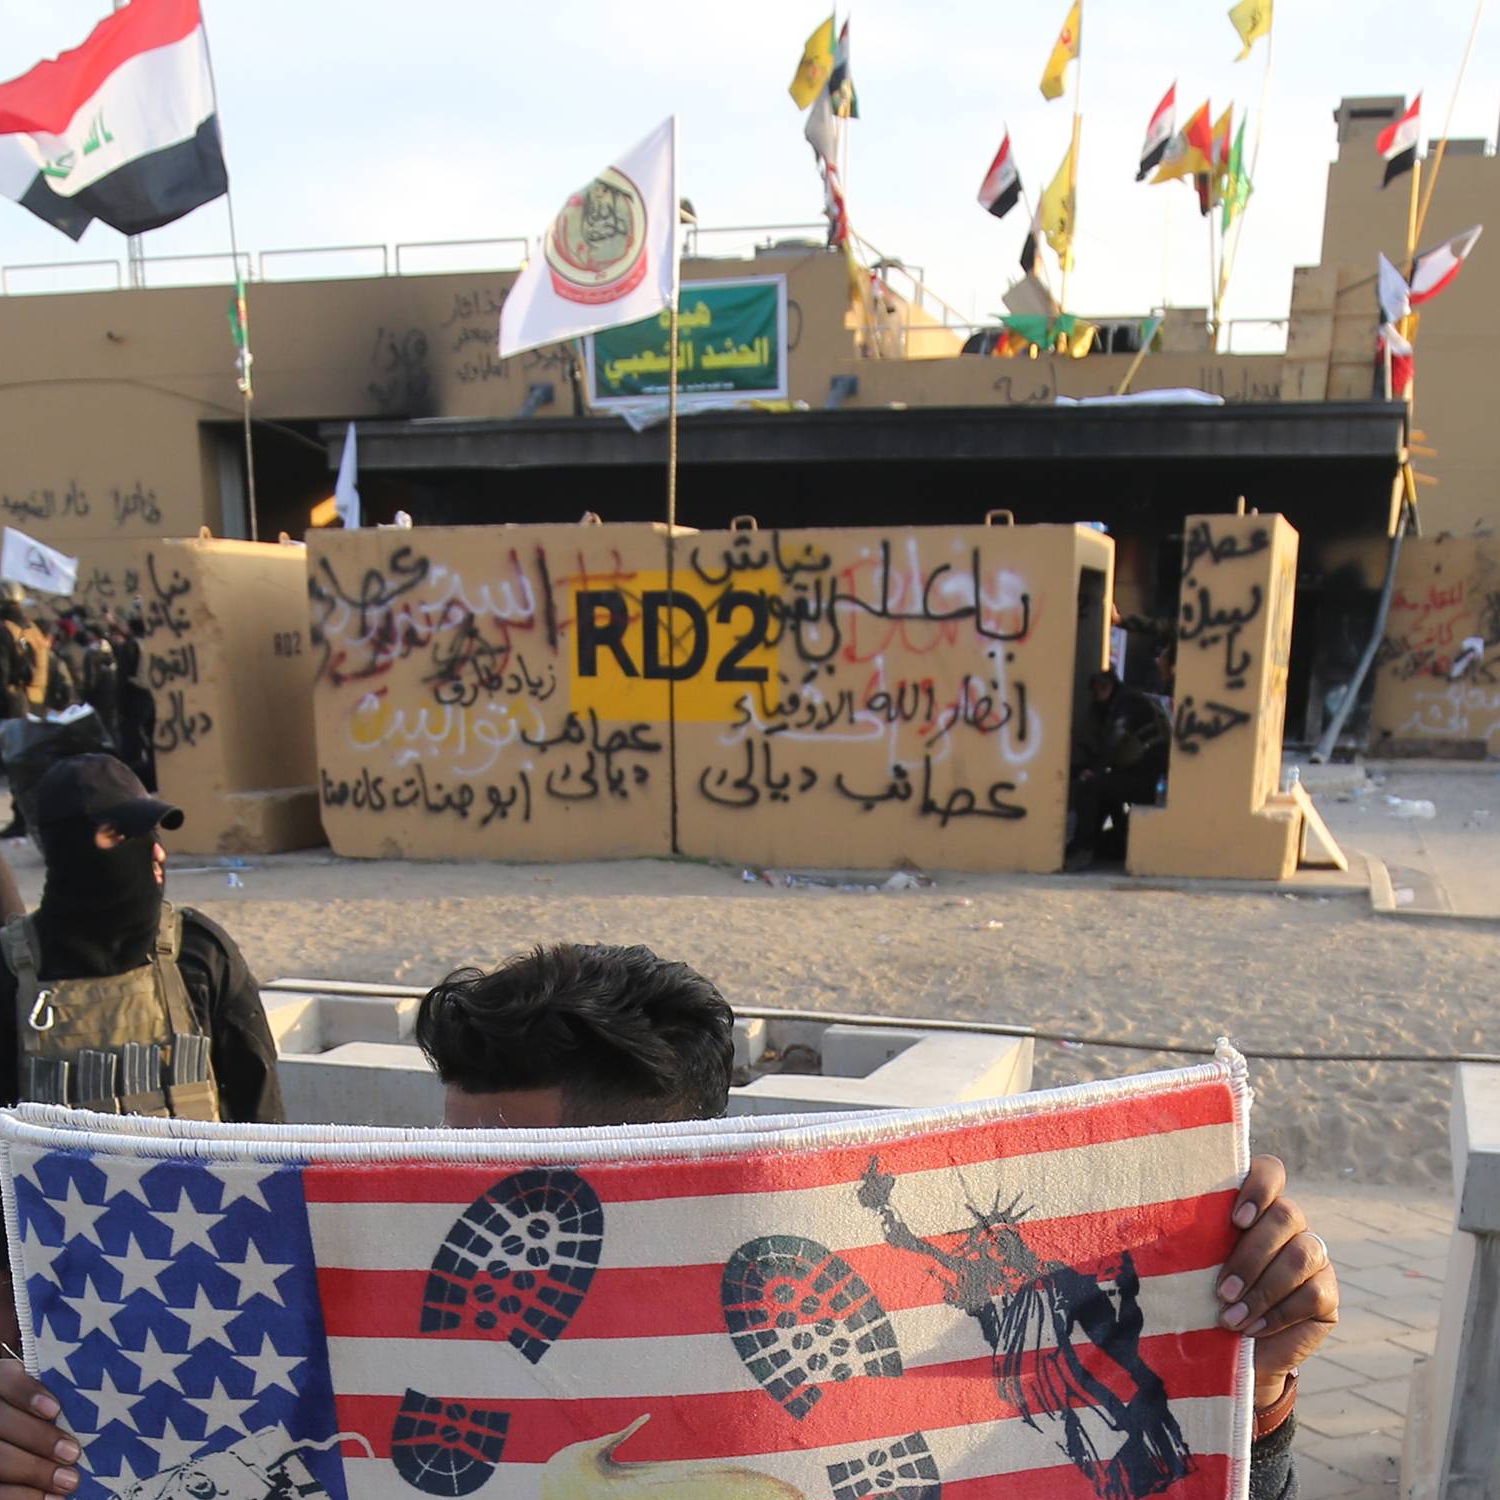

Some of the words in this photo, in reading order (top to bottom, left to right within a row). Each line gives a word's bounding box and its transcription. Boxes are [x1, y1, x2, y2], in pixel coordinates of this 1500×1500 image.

[603, 340, 695, 388] الشعبي
[701, 336, 770, 370] الحشد
[273, 631, 303, 656] RD2
[575, 586, 770, 683] RD2
